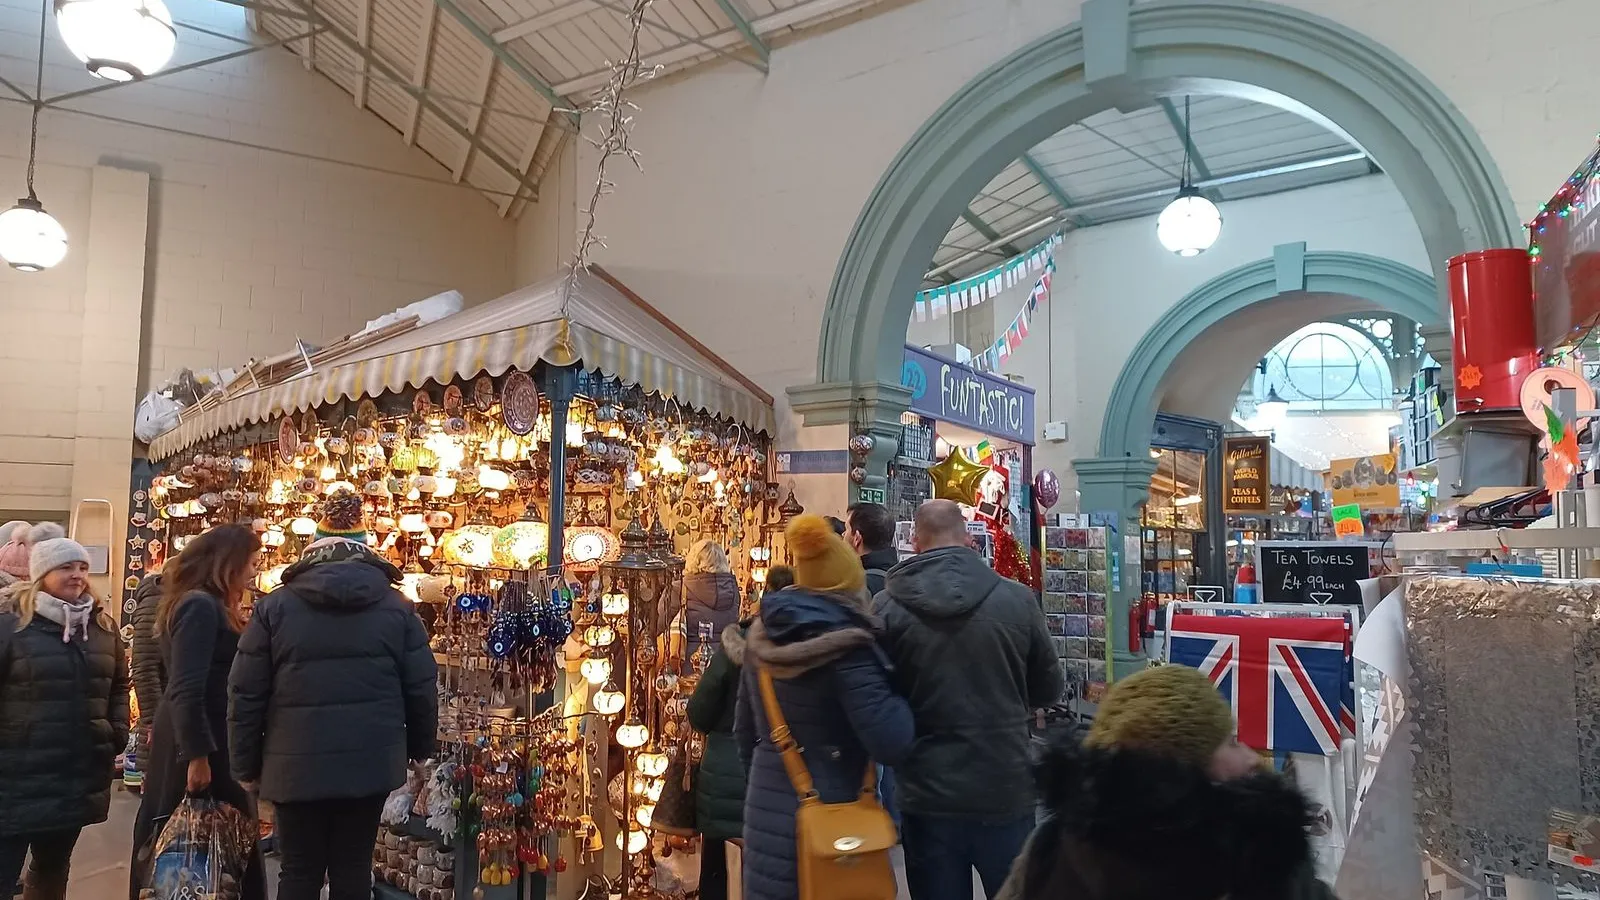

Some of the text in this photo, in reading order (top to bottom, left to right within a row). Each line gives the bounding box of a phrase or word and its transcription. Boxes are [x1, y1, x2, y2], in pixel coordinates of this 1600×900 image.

[1234, 467, 1258, 475] WORLD
[1233, 472, 1259, 480] FAMOUS
[1232, 488, 1258, 496] TEAS &
[1231, 496, 1261, 504] COFFEES
[1271, 550, 1354, 565] TEA TOWELS
[1282, 571, 1345, 591] £4.99 EACH
